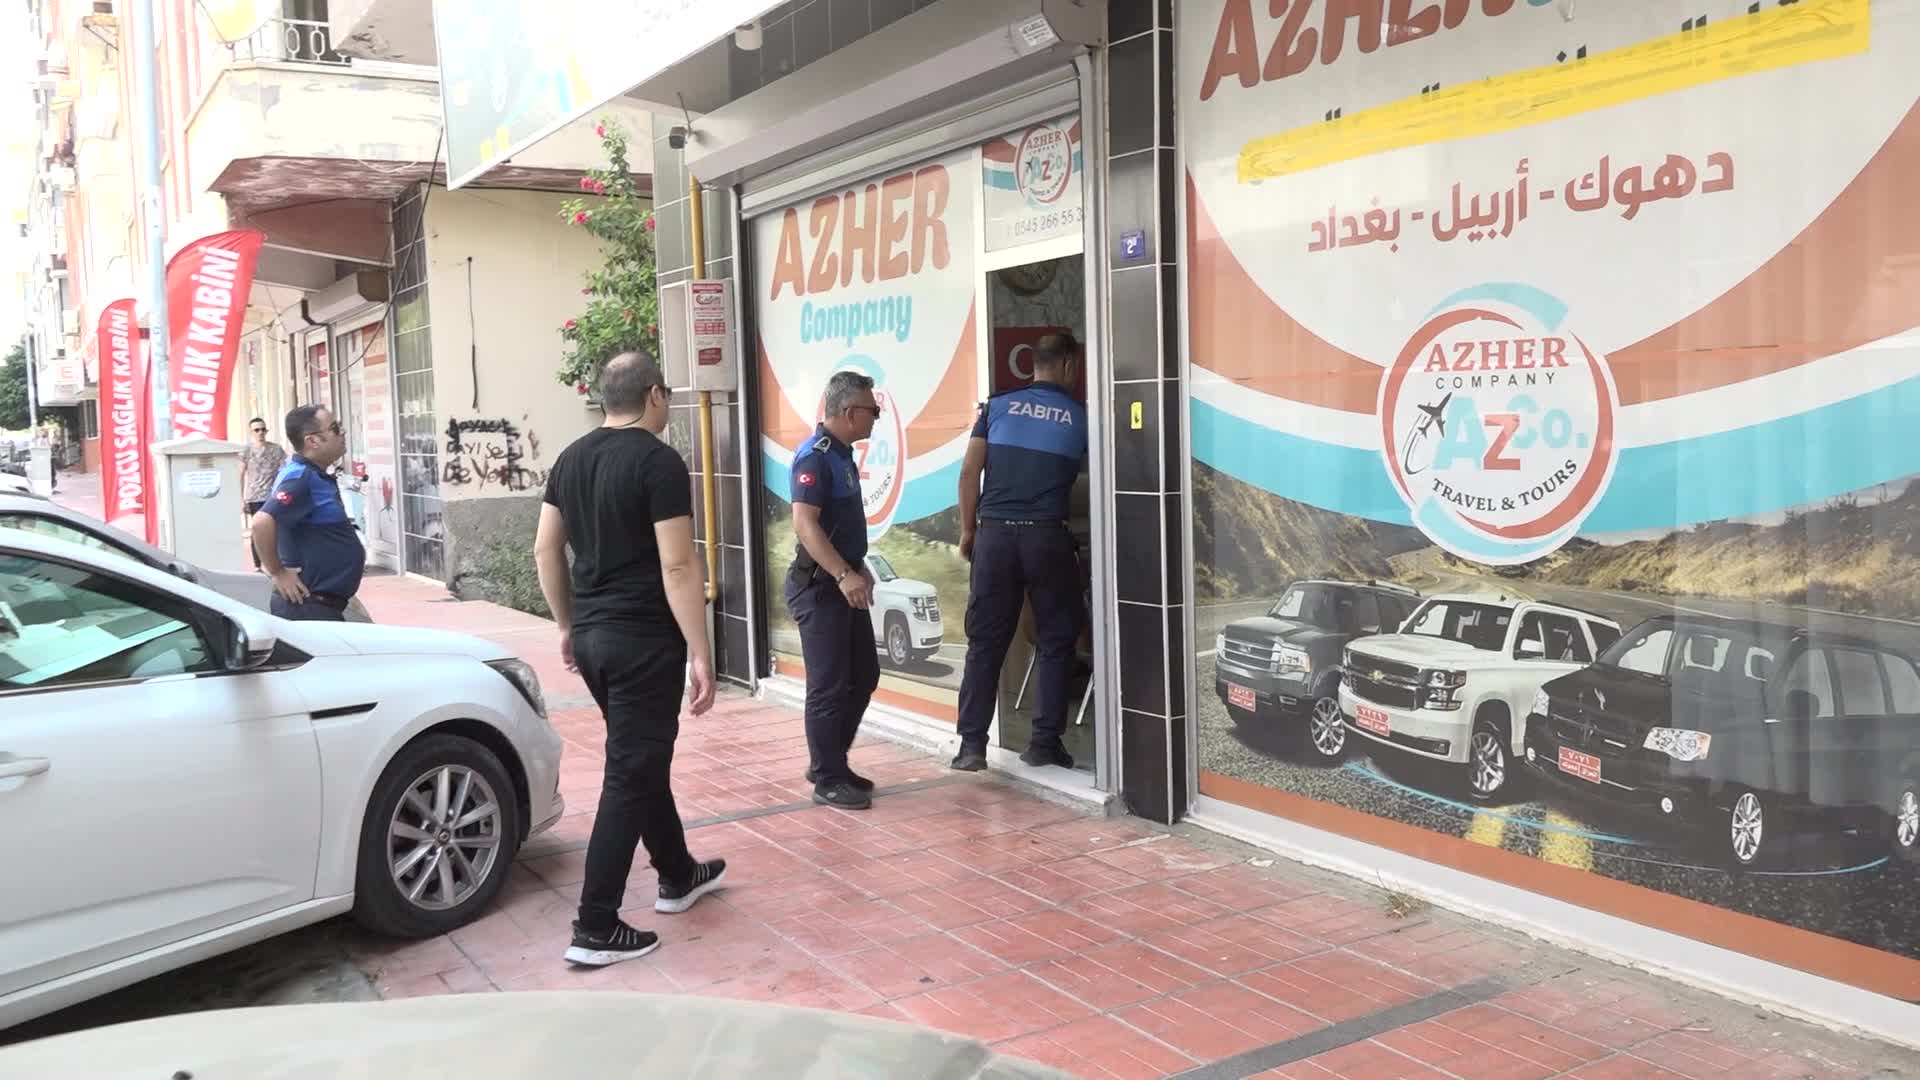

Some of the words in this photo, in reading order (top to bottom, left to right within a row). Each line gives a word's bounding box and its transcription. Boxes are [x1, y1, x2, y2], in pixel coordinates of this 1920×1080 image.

[1026, 131, 1062, 150] AZHER
[1431, 157, 1529, 243] أربيل
[1564, 151, 1734, 221] دهوك
[770, 164, 949, 301] AZHER
[1308, 195, 1400, 253] بغداد
[188, 245, 241, 345] KABİNİ
[801, 295, 912, 348] Company
[108, 308, 131, 377] KABİNİ
[1423, 336, 1569, 373] AZHER
[1435, 372, 1555, 390] COMPANY
[111, 380, 138, 449] SAĞLIK
[1008, 401, 1073, 425] ZABITA
[114, 450, 144, 511] POZCU
[1432, 478, 1497, 512] TRAVEL
[1501, 497, 1515, 510] &
[1518, 459, 1577, 507] TOURS
